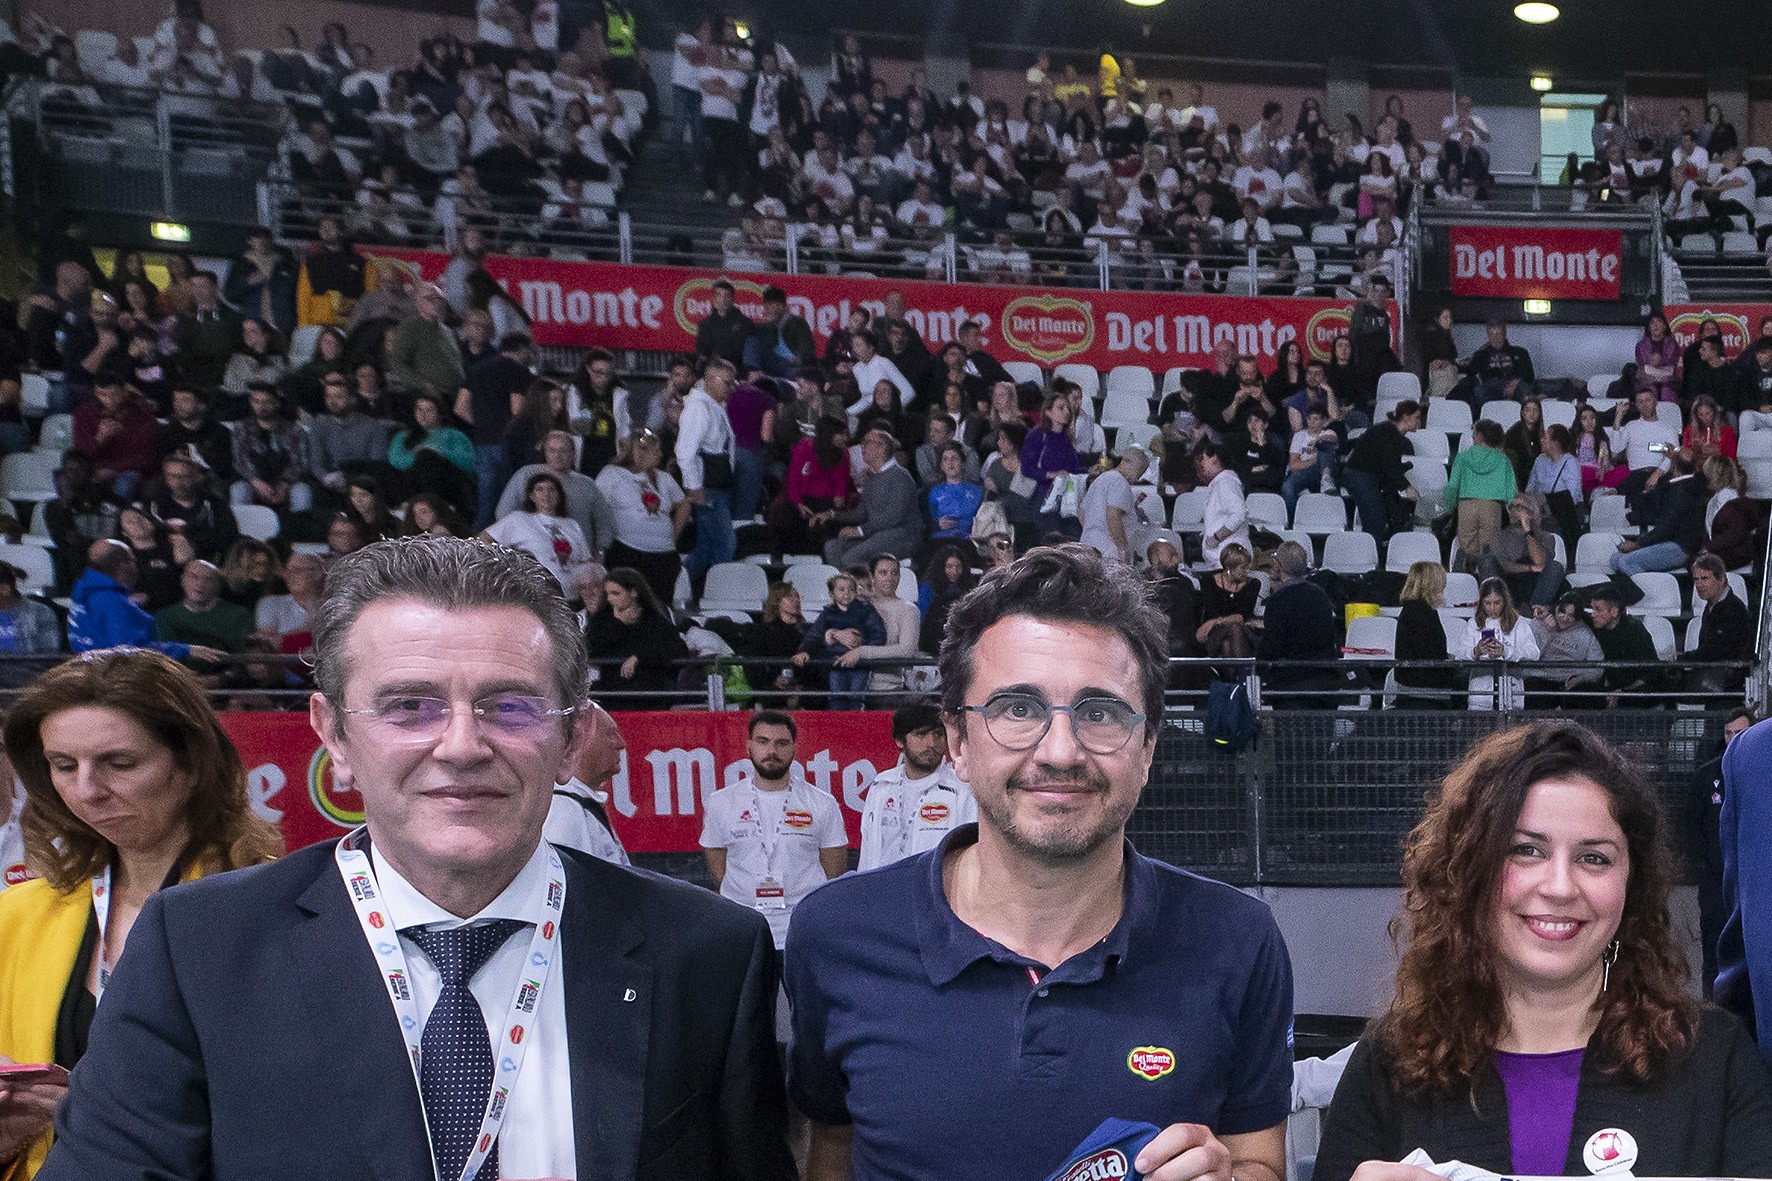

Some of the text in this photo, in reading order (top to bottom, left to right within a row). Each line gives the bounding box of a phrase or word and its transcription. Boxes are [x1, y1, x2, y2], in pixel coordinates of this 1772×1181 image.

[1454, 244, 1618, 282] Del Monte
[520, 281, 663, 329] Monte
[1105, 312, 1297, 358] Del Monte
